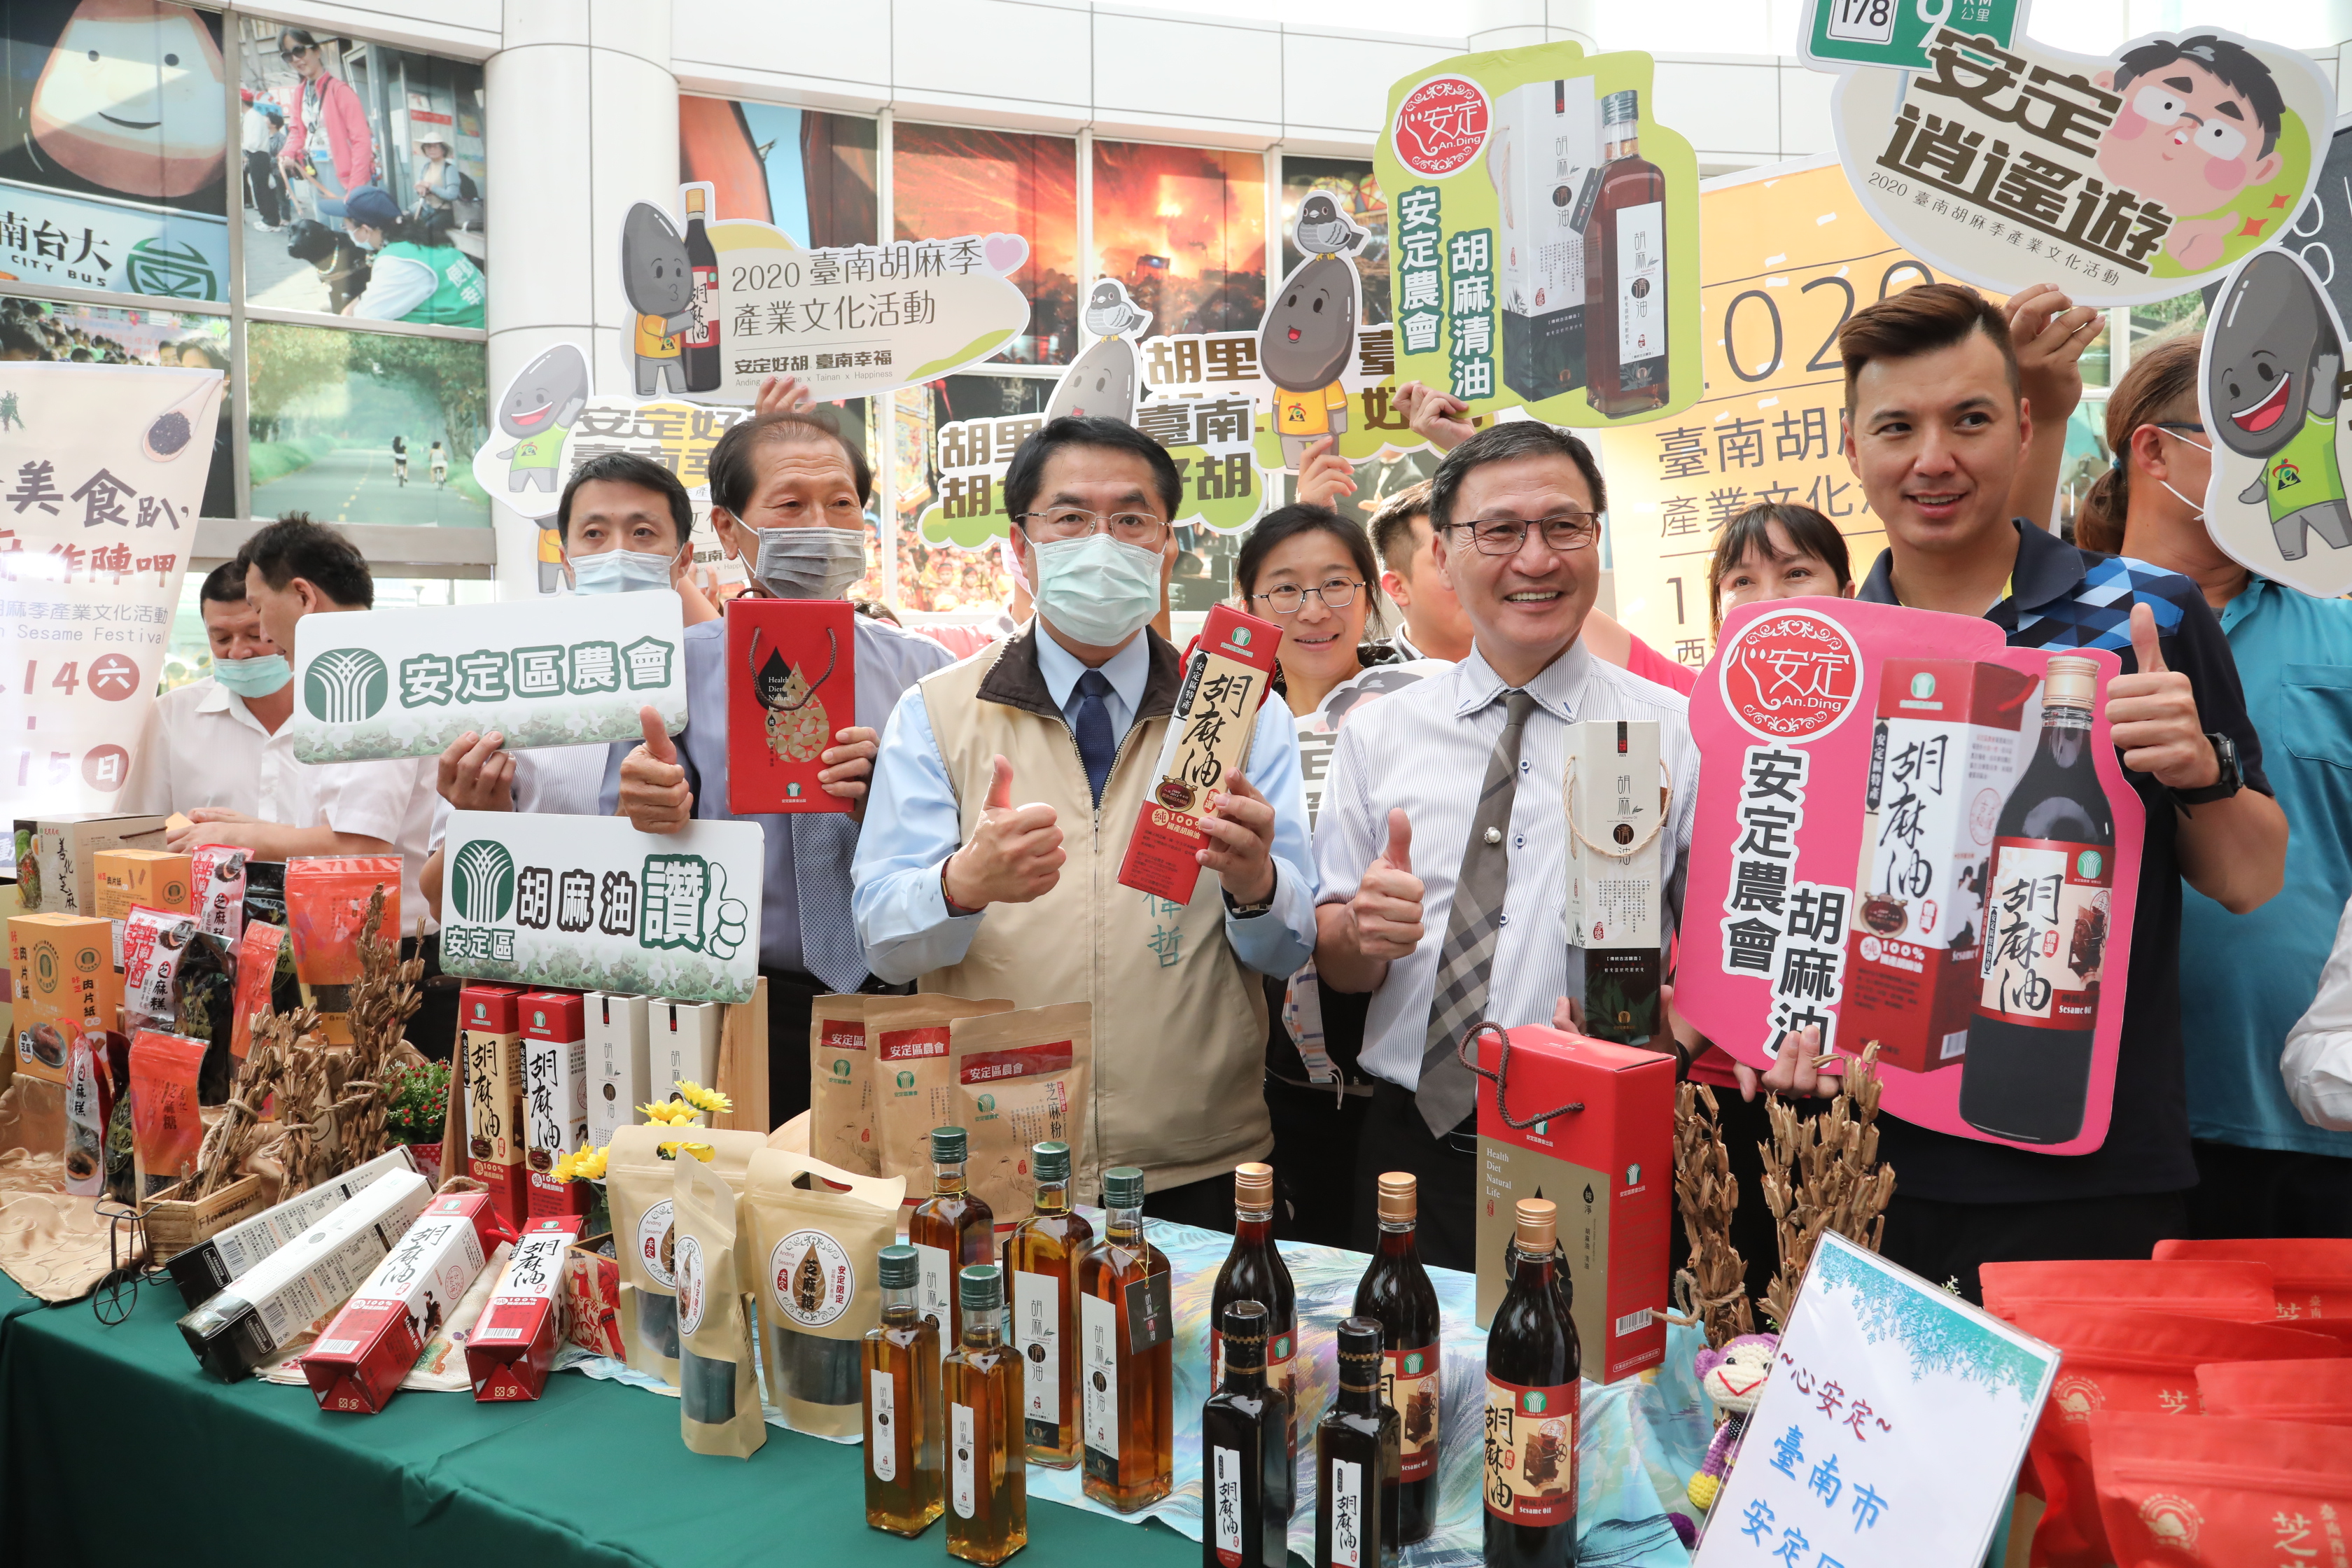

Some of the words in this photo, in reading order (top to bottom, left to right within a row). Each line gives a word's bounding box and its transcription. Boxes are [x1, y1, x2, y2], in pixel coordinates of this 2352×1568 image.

[1961, 7, 1991, 22] 公里
[1914, 28, 2123, 159] 安定
[1868, 172, 1908, 198] 2020
[1912, 189, 2120, 286] 臺南胡麻季產業文化活動
[11, 255, 53, 272] CITY
[68, 270, 106, 286] BUS
[732, 262, 800, 291] 2020
[809, 239, 983, 286] 臺南胡麻季
[1402, 190, 1439, 350] 安定農會
[1630, 230, 1649, 319] 胡麻清油
[733, 289, 935, 337] 產業文化活動
[1452, 233, 1491, 398] 胡麻清油
[816, 373, 840, 382] Tainan
[854, 370, 892, 379] Happiness
[1656, 407, 1848, 480] 臺南胡
[0, 600, 168, 624] 麻季產業文化活動
[17, 624, 83, 641] Sesame
[94, 626, 165, 645] Festival
[402, 640, 673, 705] 安定區農會
[1181, 662, 1205, 710] 安定區特產
[1182, 674, 1253, 788] 胡麻油
[1868, 732, 1886, 800] 安定區特產
[1154, 811, 1166, 824] 純
[1167, 822, 1200, 840] 國產胡麻油
[1617, 775, 1631, 866] 胡麻清油
[1879, 734, 1949, 900] 胡麻油
[57, 837, 78, 910] 善化芝麻
[1728, 749, 1802, 974] 安定農會
[445, 928, 514, 959] 安定區
[1882, 943, 1925, 962] 100%
[1994, 874, 2064, 1017] 胡麻油
[20, 947, 29, 1000] 肉片紙
[83, 979, 95, 1016] 肉片紙
[150, 962, 169, 1011] 芝麻糕
[2059, 1005, 2082, 1015] Sesame
[832, 1033, 867, 1046] 安定區
[890, 1042, 944, 1058] 安定區農會
[470, 1041, 500, 1138] 胡麻油
[894, 1089, 918, 1098] 安定區農會
[970, 1063, 1023, 1081] 安定區農會
[529, 1050, 561, 1149] 胡麻油
[1044, 1082, 1061, 1139] 芝麻粉
[1057, 1082, 1067, 1112] 安定區特產
[1487, 1147, 1509, 1163] Health
[1527, 1134, 1553, 1147] 安定區農會出品
[483, 1163, 503, 1173] 100%
[1487, 1161, 1501, 1173] Diet
[1487, 1173, 1512, 1190] Natural
[1487, 1186, 1501, 1198] Life
[1620, 1185, 1646, 1198] 安定區農會出品
[379, 1225, 452, 1288] 胡麻油
[512, 1239, 561, 1288] 胡麻油
[646, 1240, 654, 1259] 安定
[778, 1271, 788, 1290] 安定
[802, 1259, 817, 1310] 芝麻糖
[836, 1265, 846, 1304] 安定限定
[404, 1315, 416, 1340] Sesame
[1031, 1300, 1043, 1382] 胡麻清油
[1094, 1325, 1105, 1413] 胡麻清油
[1401, 1462, 1421, 1471] Sesame
[1484, 1405, 1514, 1508] 胡麻油
[1770, 1424, 1889, 1533] 臺南市
[1219, 1481, 1238, 1535] 胡麻油
[1336, 1495, 1357, 1550] 胡麻油
